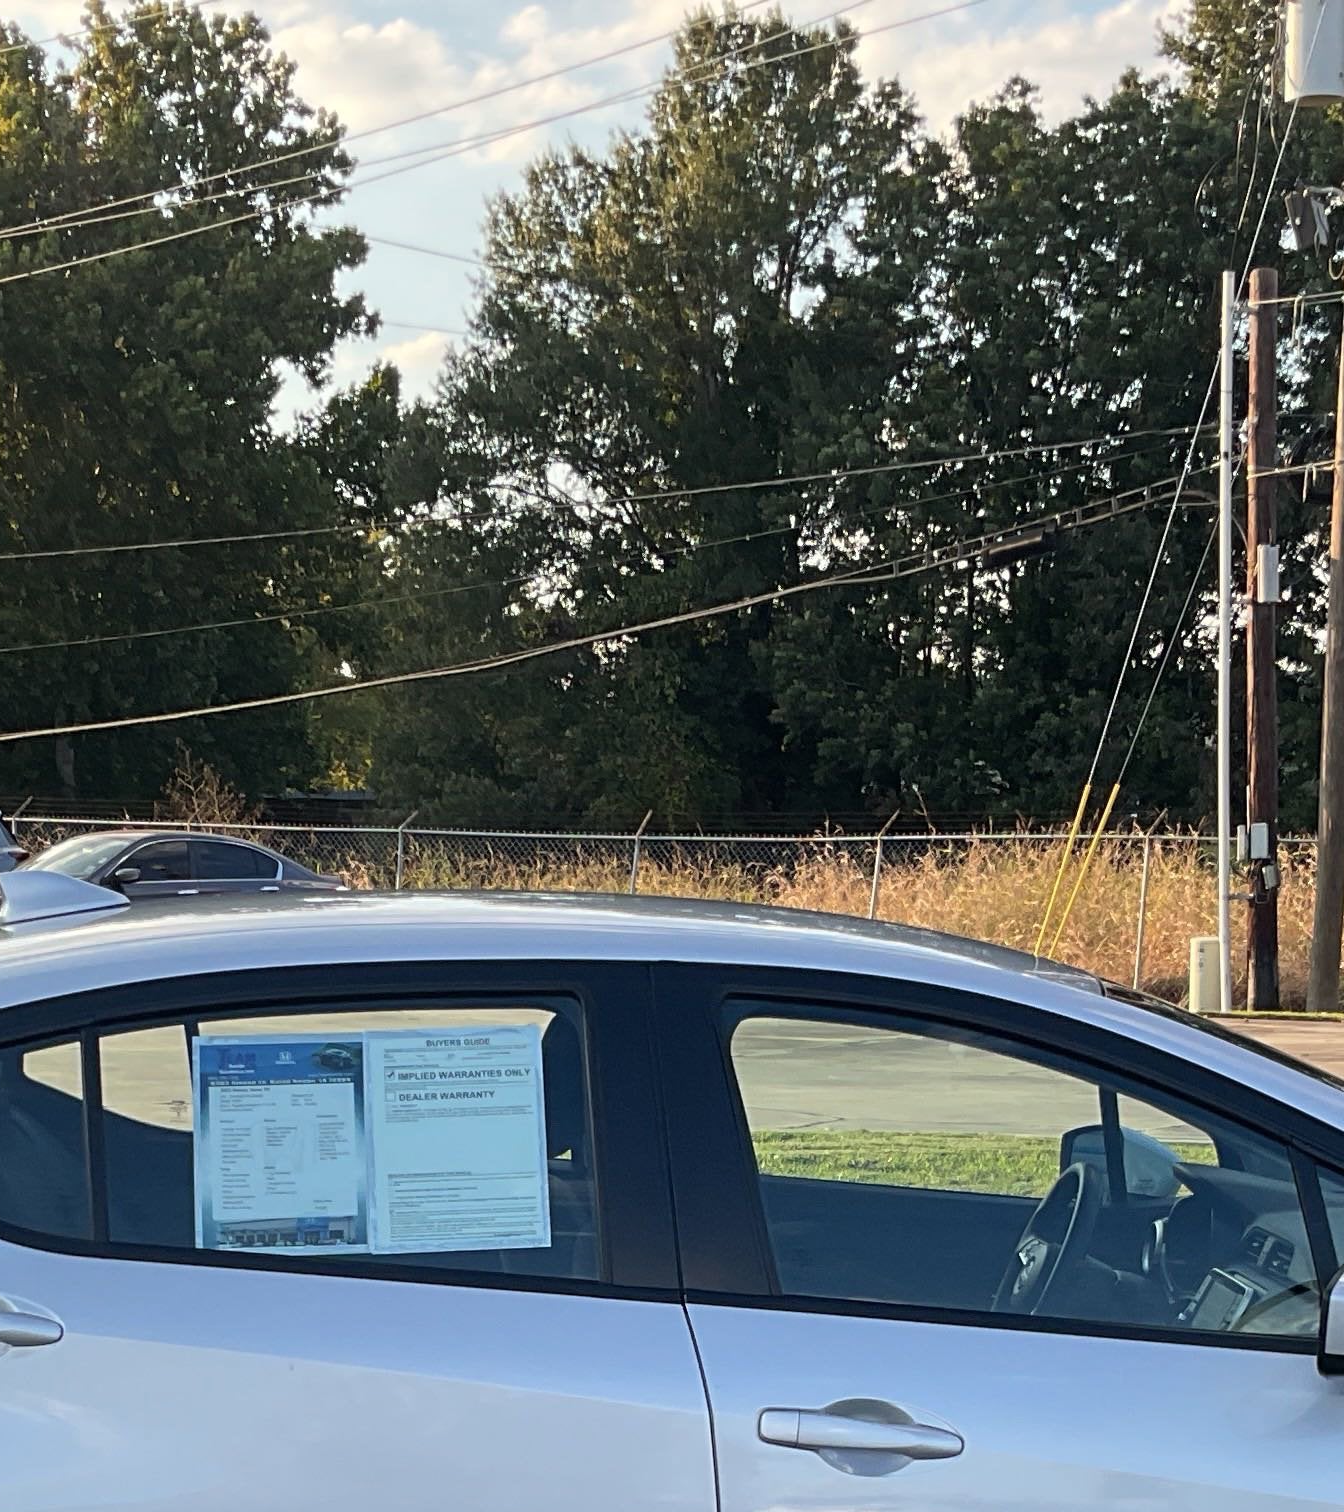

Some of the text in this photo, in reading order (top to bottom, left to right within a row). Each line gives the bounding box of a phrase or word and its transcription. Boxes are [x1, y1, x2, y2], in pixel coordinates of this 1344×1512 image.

[425, 1037, 490, 1047] BUYERS GUIDE
[397, 1068, 531, 1081] IMPLIED WARRANTIES ONLY
[399, 1090, 495, 1102] DEALER WARRANTY
